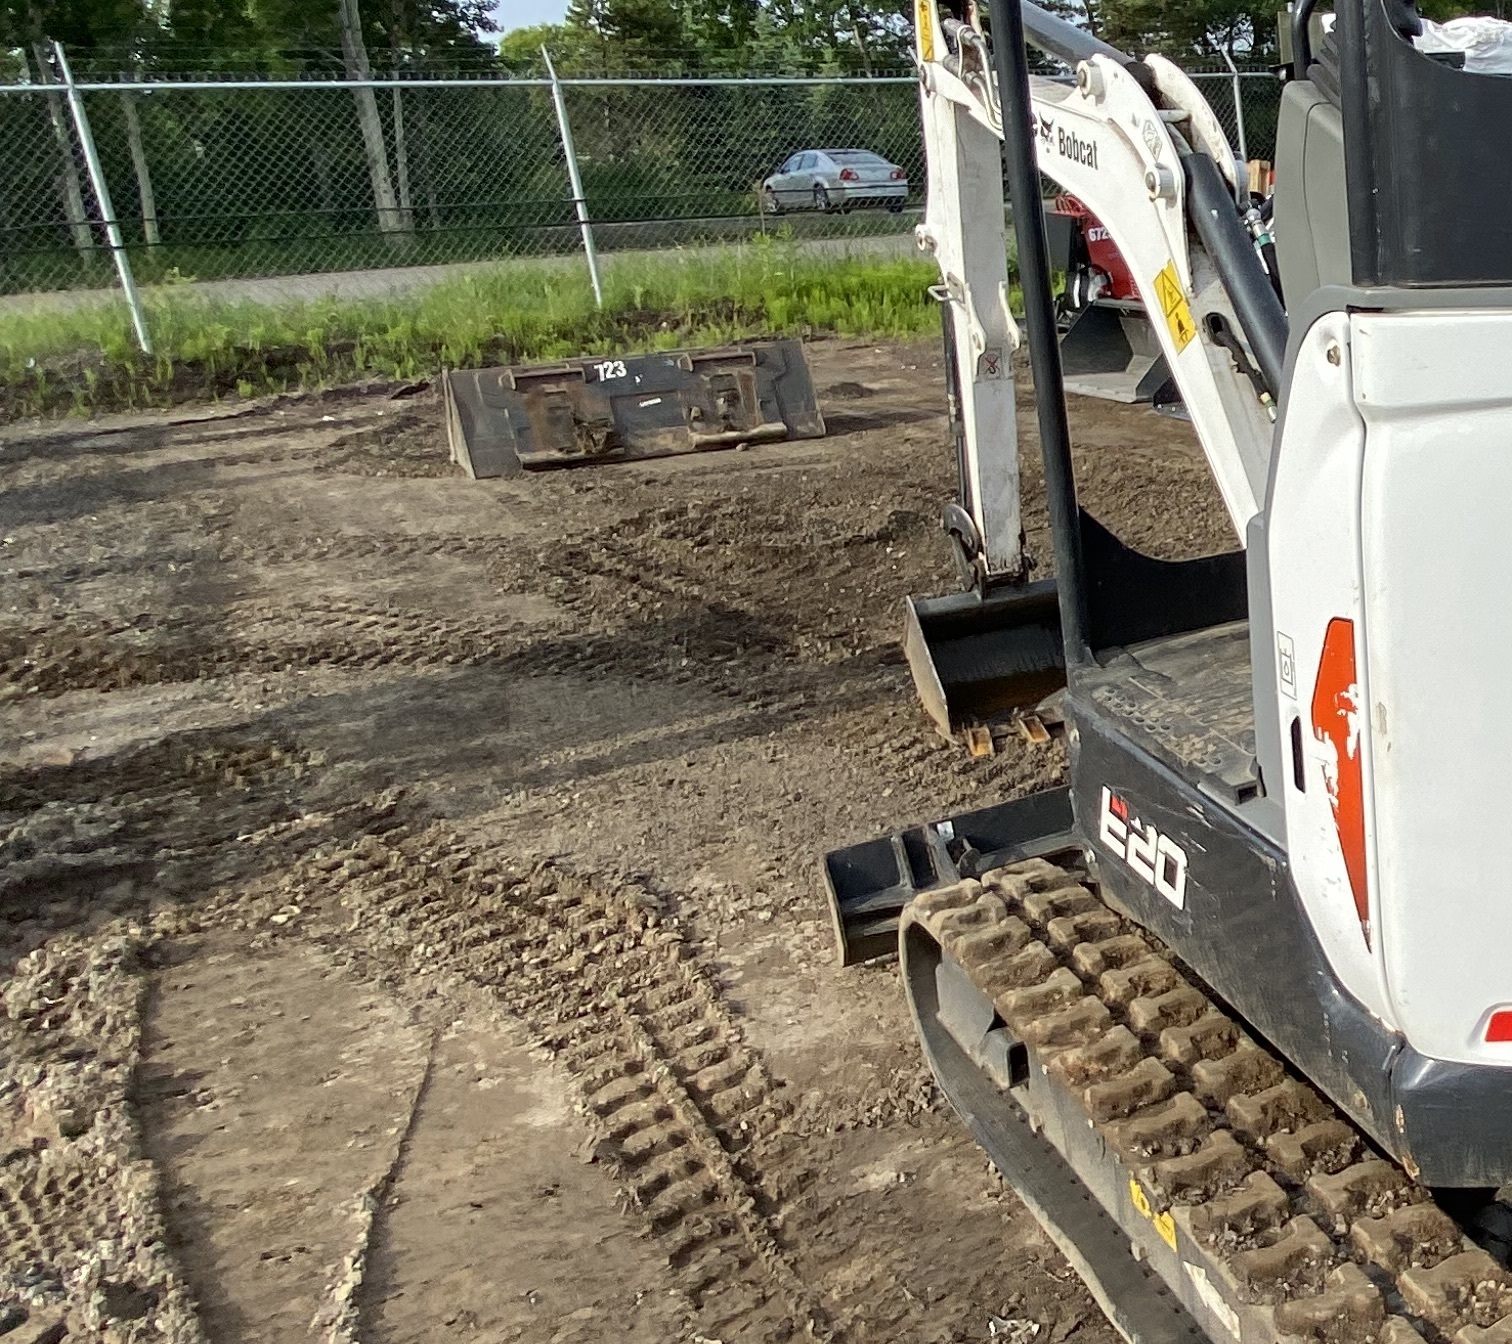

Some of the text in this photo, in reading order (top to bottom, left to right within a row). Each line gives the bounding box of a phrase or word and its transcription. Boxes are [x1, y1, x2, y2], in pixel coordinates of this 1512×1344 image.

[1057, 126, 1099, 170] Bobcat
[1088, 227, 1112, 242] 672
[593, 360, 627, 382] 723
